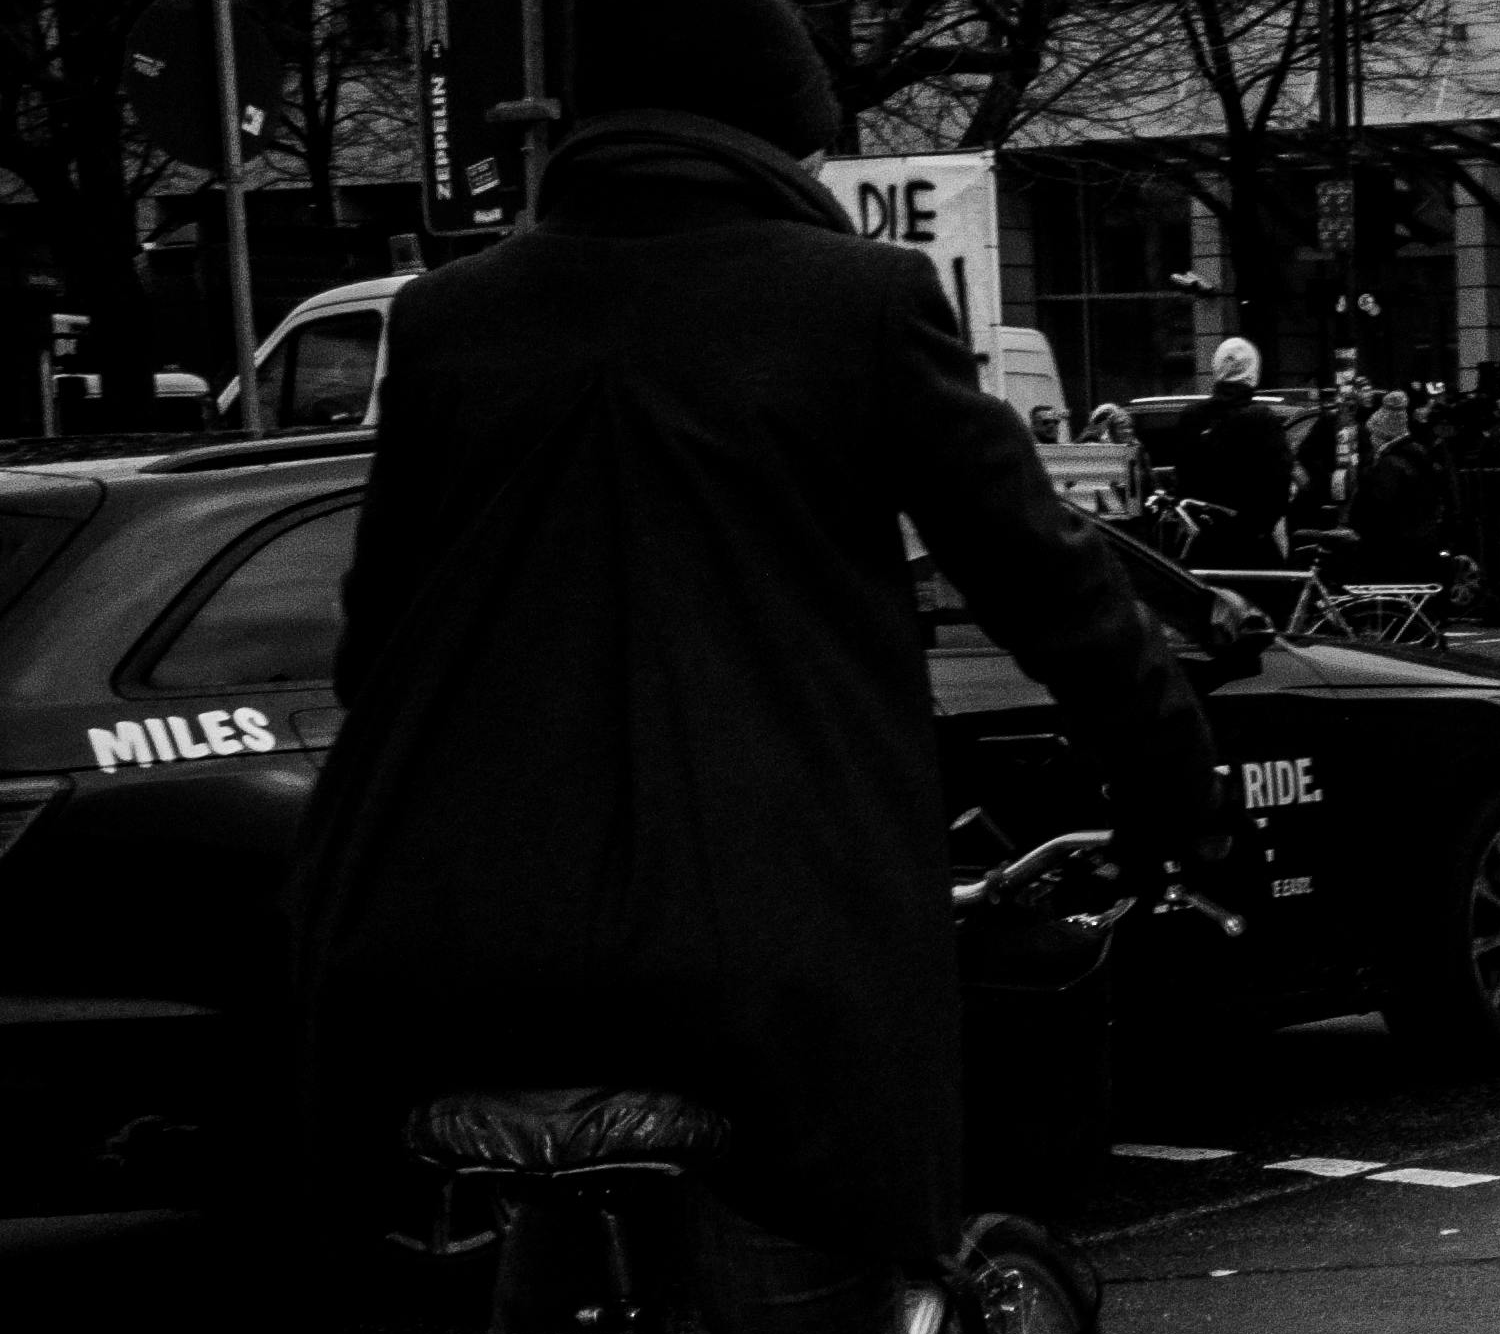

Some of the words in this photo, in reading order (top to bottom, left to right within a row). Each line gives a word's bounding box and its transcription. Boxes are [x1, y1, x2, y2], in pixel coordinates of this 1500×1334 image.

[430, 72, 453, 200] ZEPPELIN
[857, 180, 937, 242] DIE
[87, 705, 277, 775] MILES
